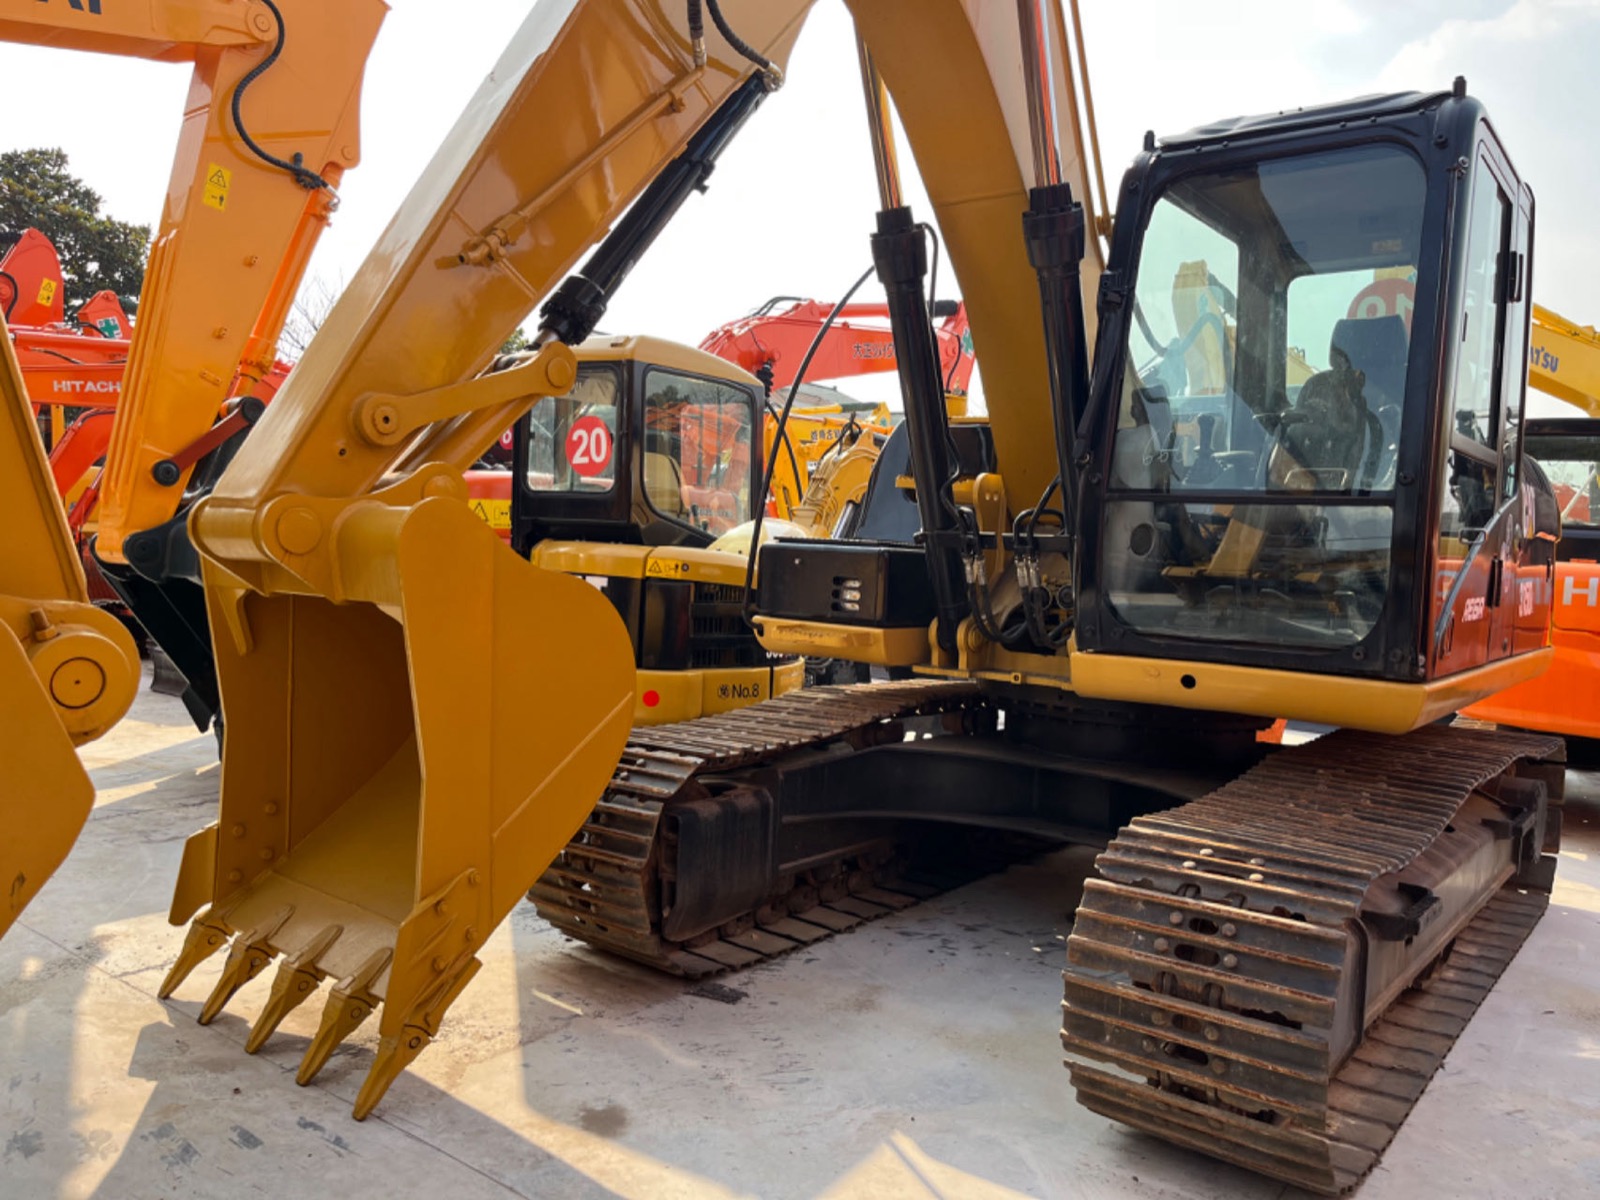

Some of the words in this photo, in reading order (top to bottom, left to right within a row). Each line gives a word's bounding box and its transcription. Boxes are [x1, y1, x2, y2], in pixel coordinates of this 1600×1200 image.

[572, 427, 607, 464] 20
[1562, 576, 1599, 607] H
[732, 684, 760, 698] No.8
